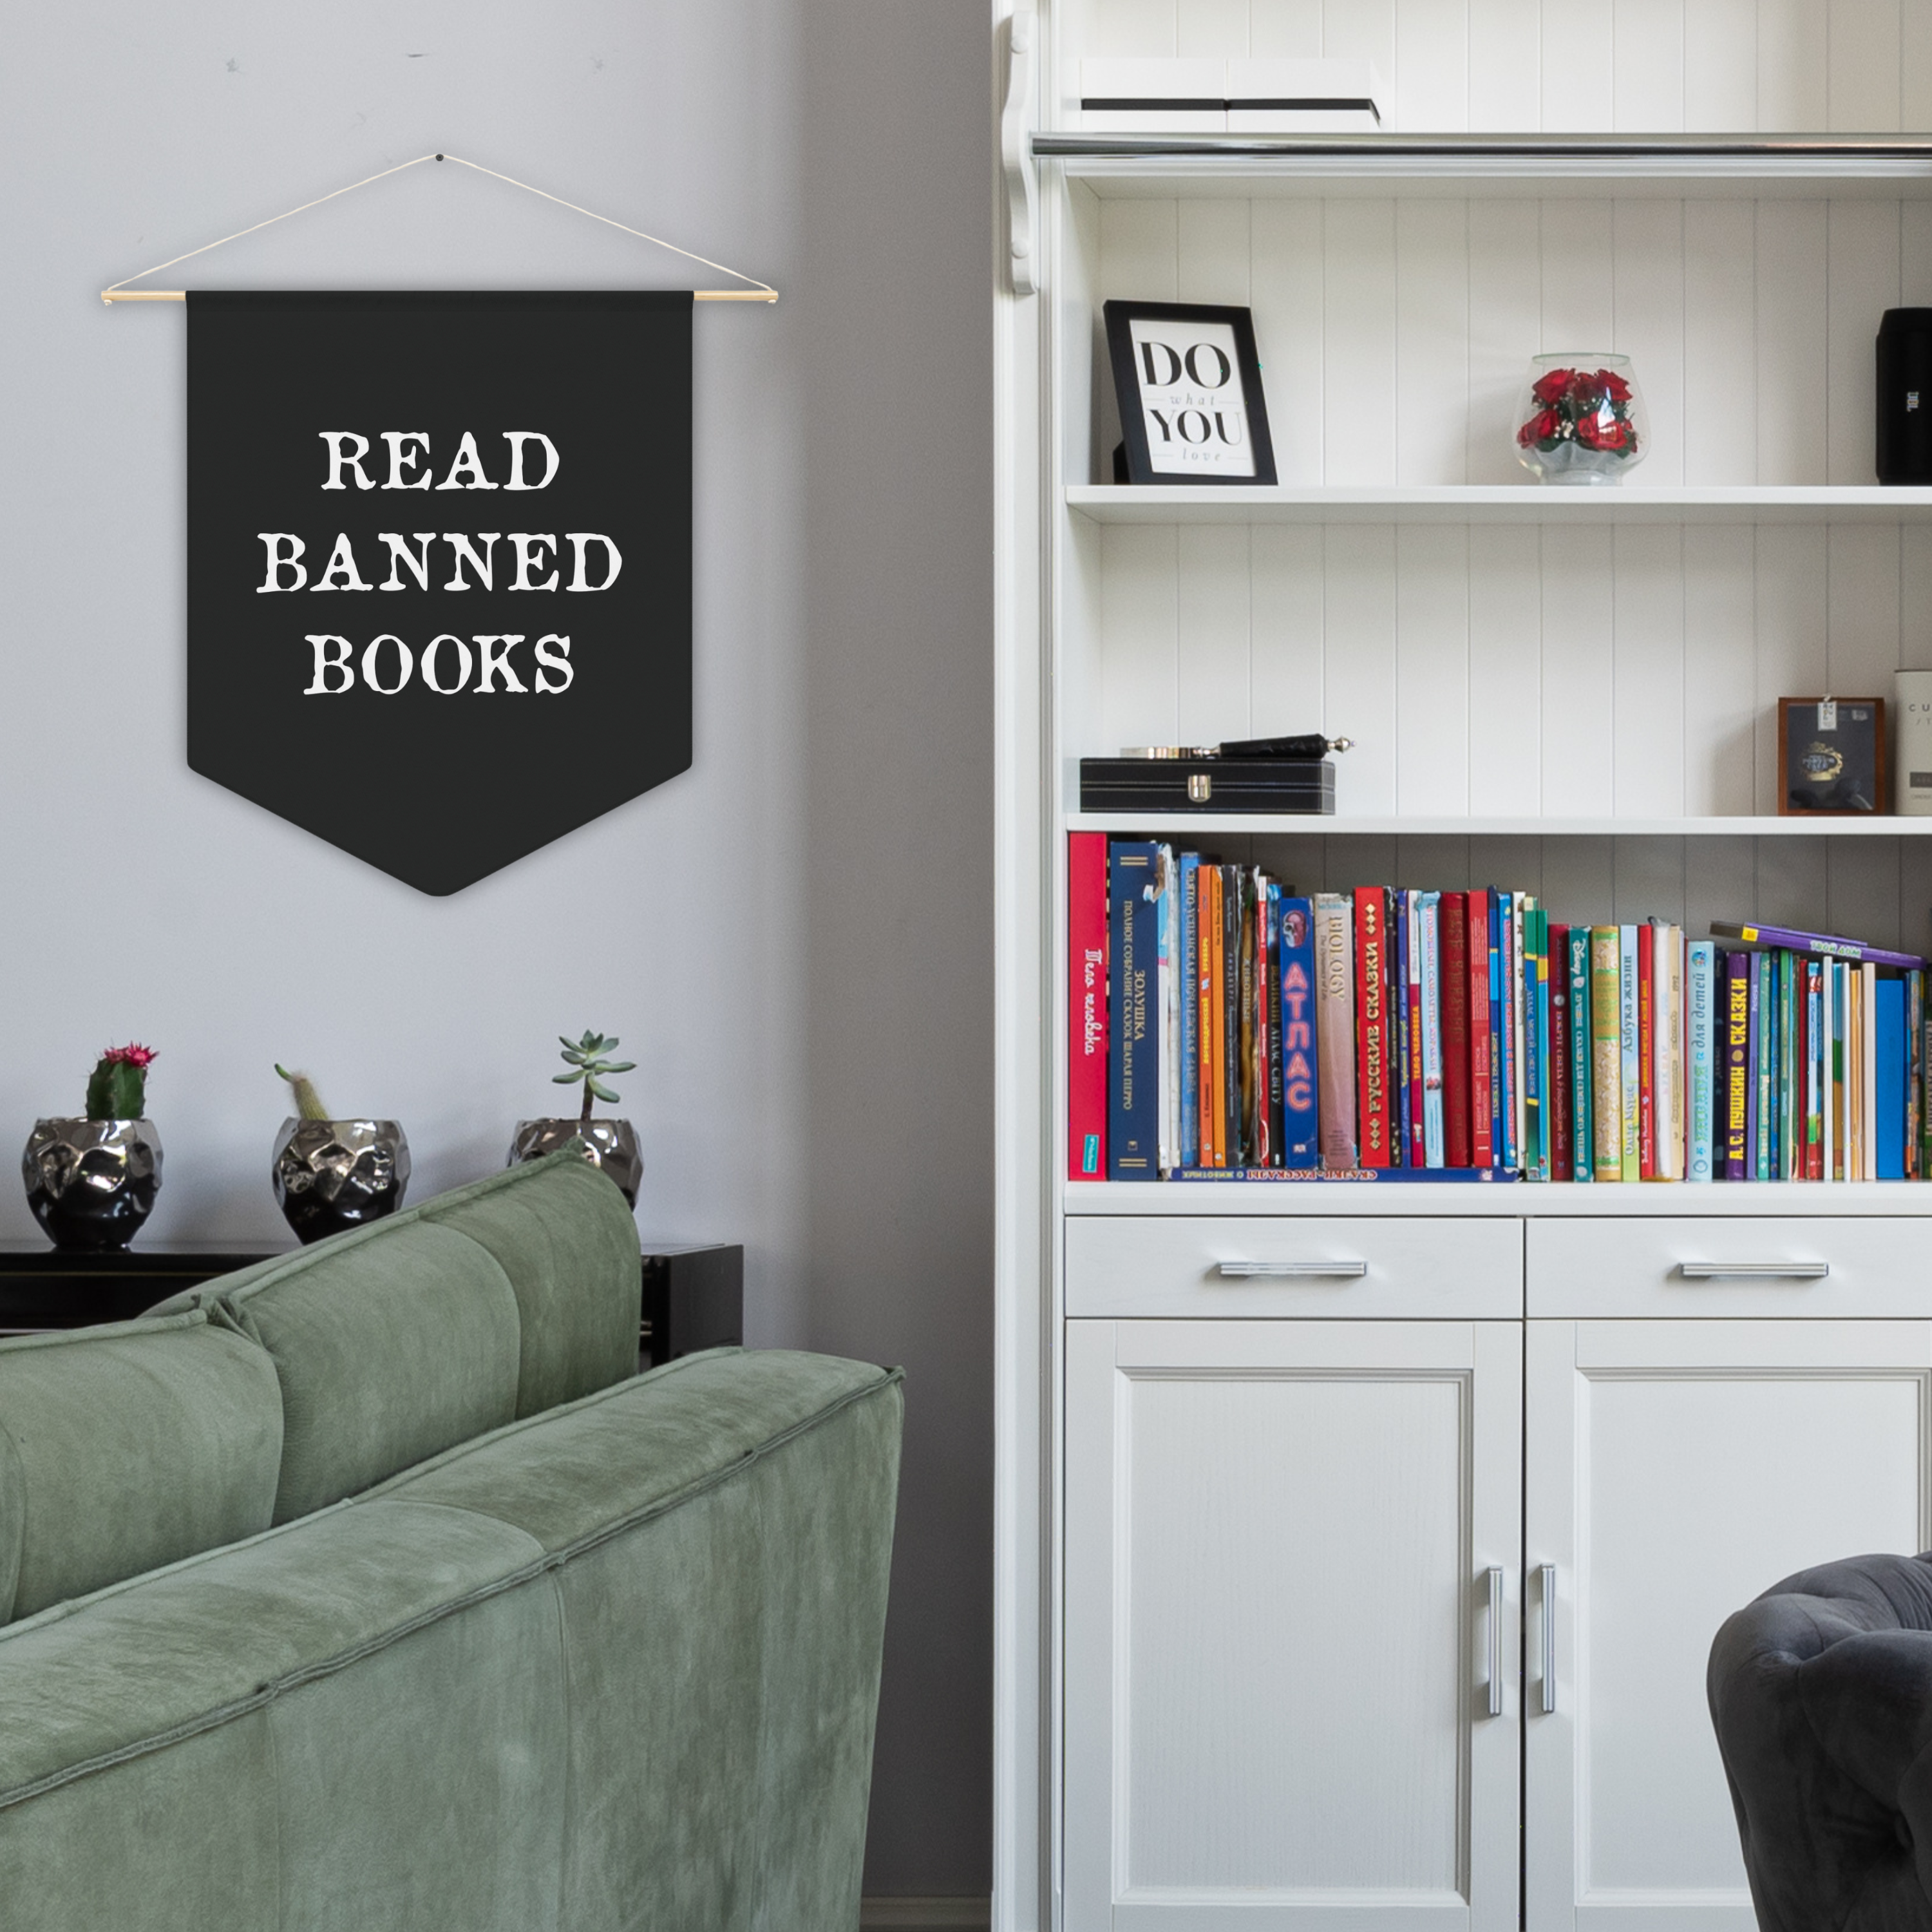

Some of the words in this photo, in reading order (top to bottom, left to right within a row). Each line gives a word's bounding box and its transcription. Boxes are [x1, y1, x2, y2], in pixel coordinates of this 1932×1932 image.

[1137, 341, 1231, 389] DO
[1169, 393, 1216, 406] what
[1146, 409, 1243, 446] YOU
[319, 431, 560, 491] READ
[1182, 448, 1222, 461] love
[256, 532, 623, 593] BANNED
[303, 634, 574, 695] BOOKS
[1123, 900, 1133, 943] ПОЛНОЕ
[1084, 949, 1103, 988] Тело
[1329, 916, 1346, 1002] BIOLOGY
[1570, 938, 1586, 975] Disney
[1810, 940, 1837, 954] ТВОЙ
[1838, 945, 1861, 959] ДОМ
[1124, 944, 1133, 997] СОБРАНИЕ
[1242, 957, 1252, 1023] ЖИВОТНЫЕ
[1366, 941, 1379, 1019] СКАЗКИ
[1622, 955, 1633, 1000] жизни
[1133, 970, 1146, 1041] ЗОЛУШКА
[1271, 965, 1280, 1023] ВЕЛИКИЙ
[1320, 989, 1329, 1002] Life
[1575, 992, 1584, 1027] ЛУЧШИЕ
[1689, 973, 1707, 1019] детей
[1730, 978, 1747, 1046] СКАЗКИ
[1084, 993, 1103, 1056] человека
[1123, 999, 1133, 1039] СКАЗОК
[1283, 961, 1312, 1112] АТЛАС
[1528, 1018, 1537, 1048] МОРЕЙ
[1622, 1003, 1636, 1054] Азбука
[1690, 1023, 1706, 1048] для
[1123, 1041, 1132, 1076] ШАРЛЯ
[1271, 1027, 1281, 1065] АТЛАС
[1576, 1030, 1584, 1062] СКАЗКИ
[1271, 1066, 1282, 1105] СВІТУ
[1367, 1025, 1381, 1113] РУССКИЕ
[1529, 1056, 1537, 1095] ОКЕАНОВ
[1123, 1078, 1132, 1110] ПЕРРО
[1576, 1081, 1586, 1130] СЕМЕЙНОГО
[1729, 1066, 1745, 1130] ПУШКИН
[1577, 1131, 1586, 1162] ЧТЕНИЯ
[1729, 1147, 1744, 1160] А.
[1730, 1133, 1744, 1146] С.
[1182, 1171, 1235, 1179] ЖИВОТНЫХ
[1236, 1171, 1244, 1179] О
